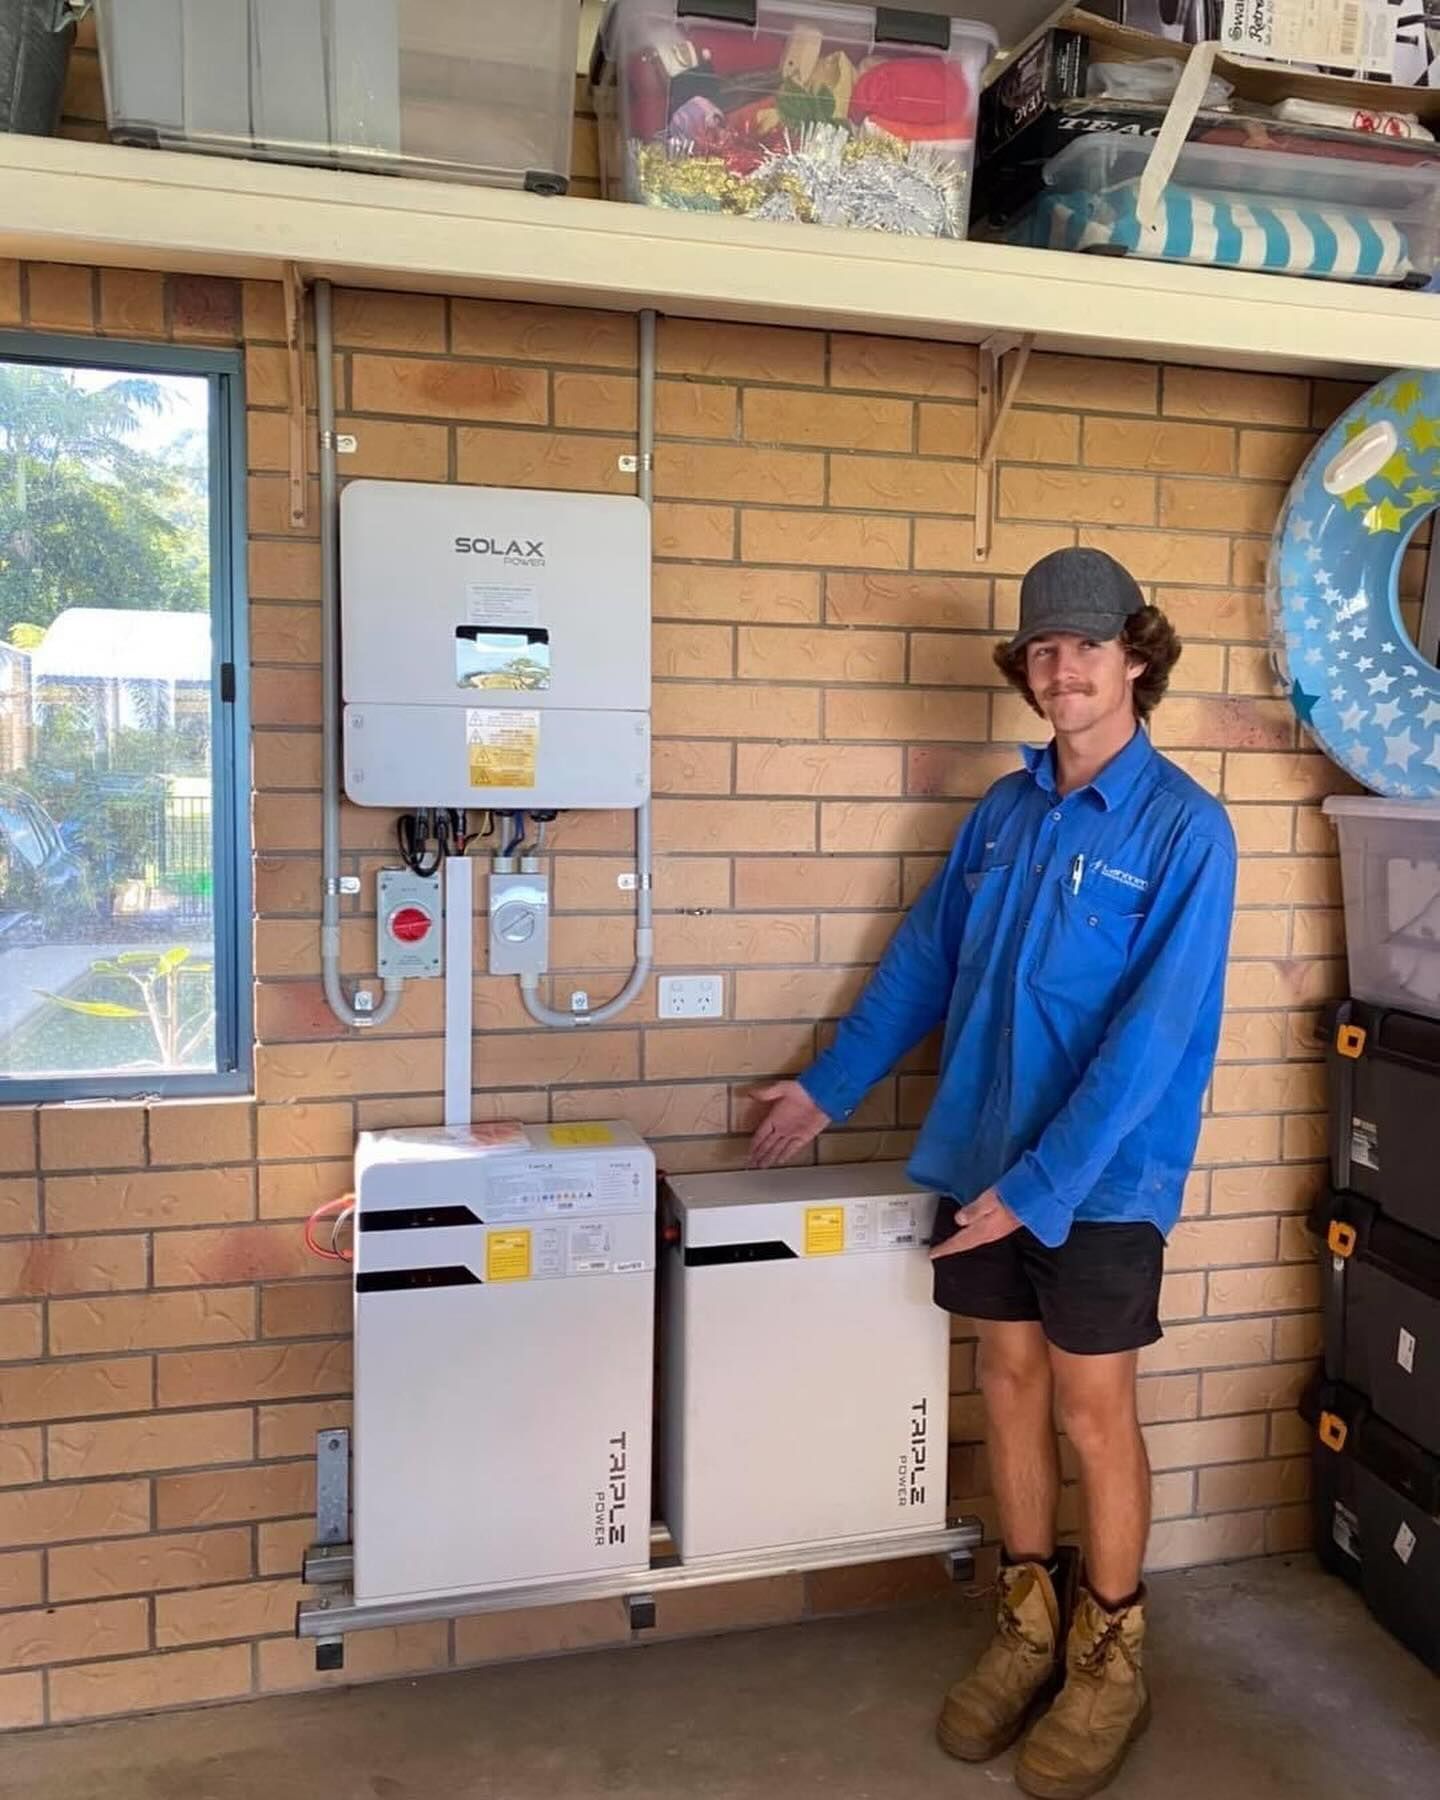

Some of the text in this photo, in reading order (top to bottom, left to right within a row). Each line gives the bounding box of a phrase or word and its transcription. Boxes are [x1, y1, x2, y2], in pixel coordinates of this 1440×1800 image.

[1228, 0, 1244, 41] Swa
[455, 537, 544, 557] SOLAX
[503, 557, 546, 567] POWER
[911, 1398, 926, 1505] TRIPLE
[609, 1431, 626, 1544] TRIPLE
[898, 1455, 908, 1506] POWER
[594, 1492, 605, 1546] POWER
